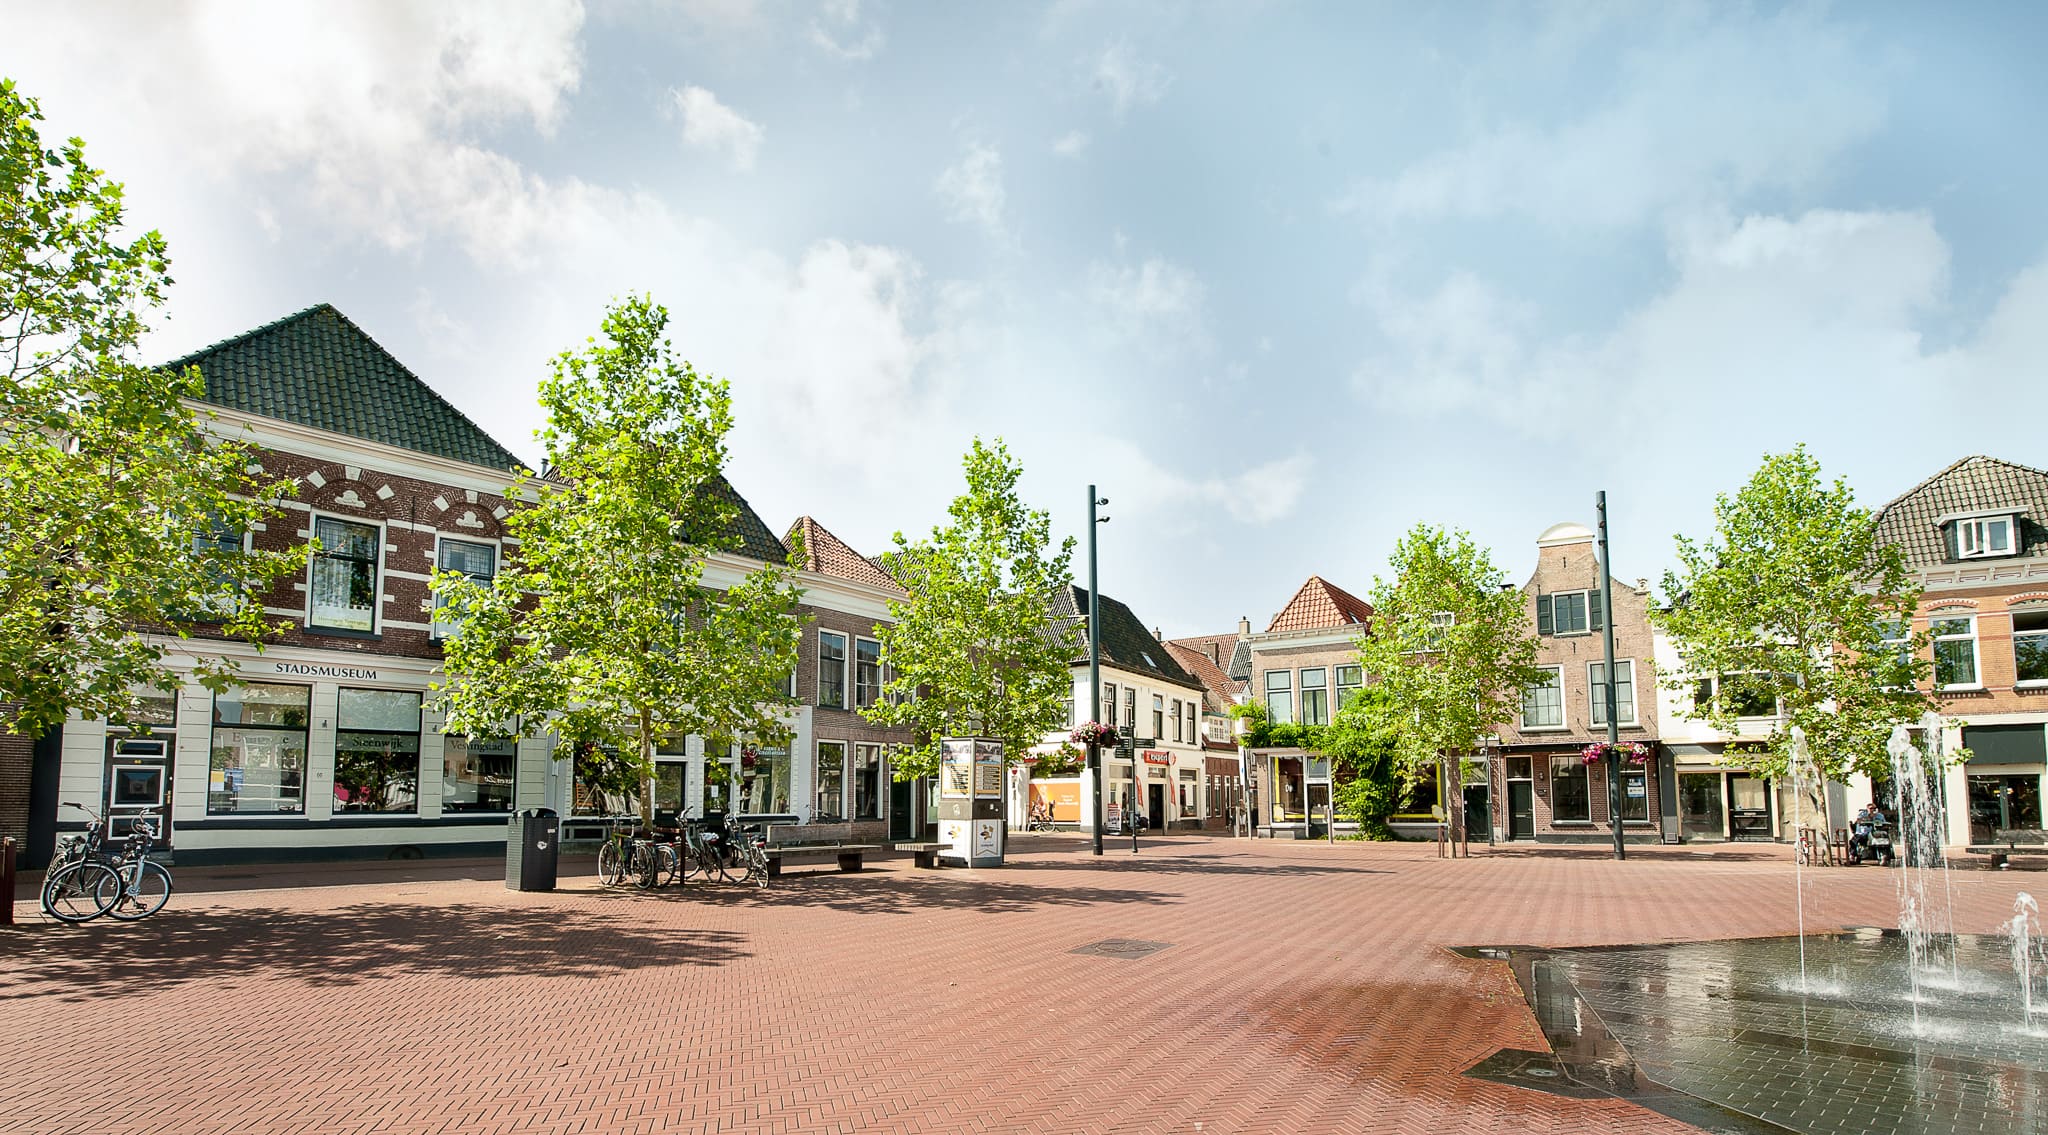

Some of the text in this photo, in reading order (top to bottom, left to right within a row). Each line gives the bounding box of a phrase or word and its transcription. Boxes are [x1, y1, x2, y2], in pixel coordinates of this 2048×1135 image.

[276, 663, 377, 679] STADSMUSEUM
[352, 736, 404, 749] Steenwijk
[451, 740, 503, 752] Vestingstad
